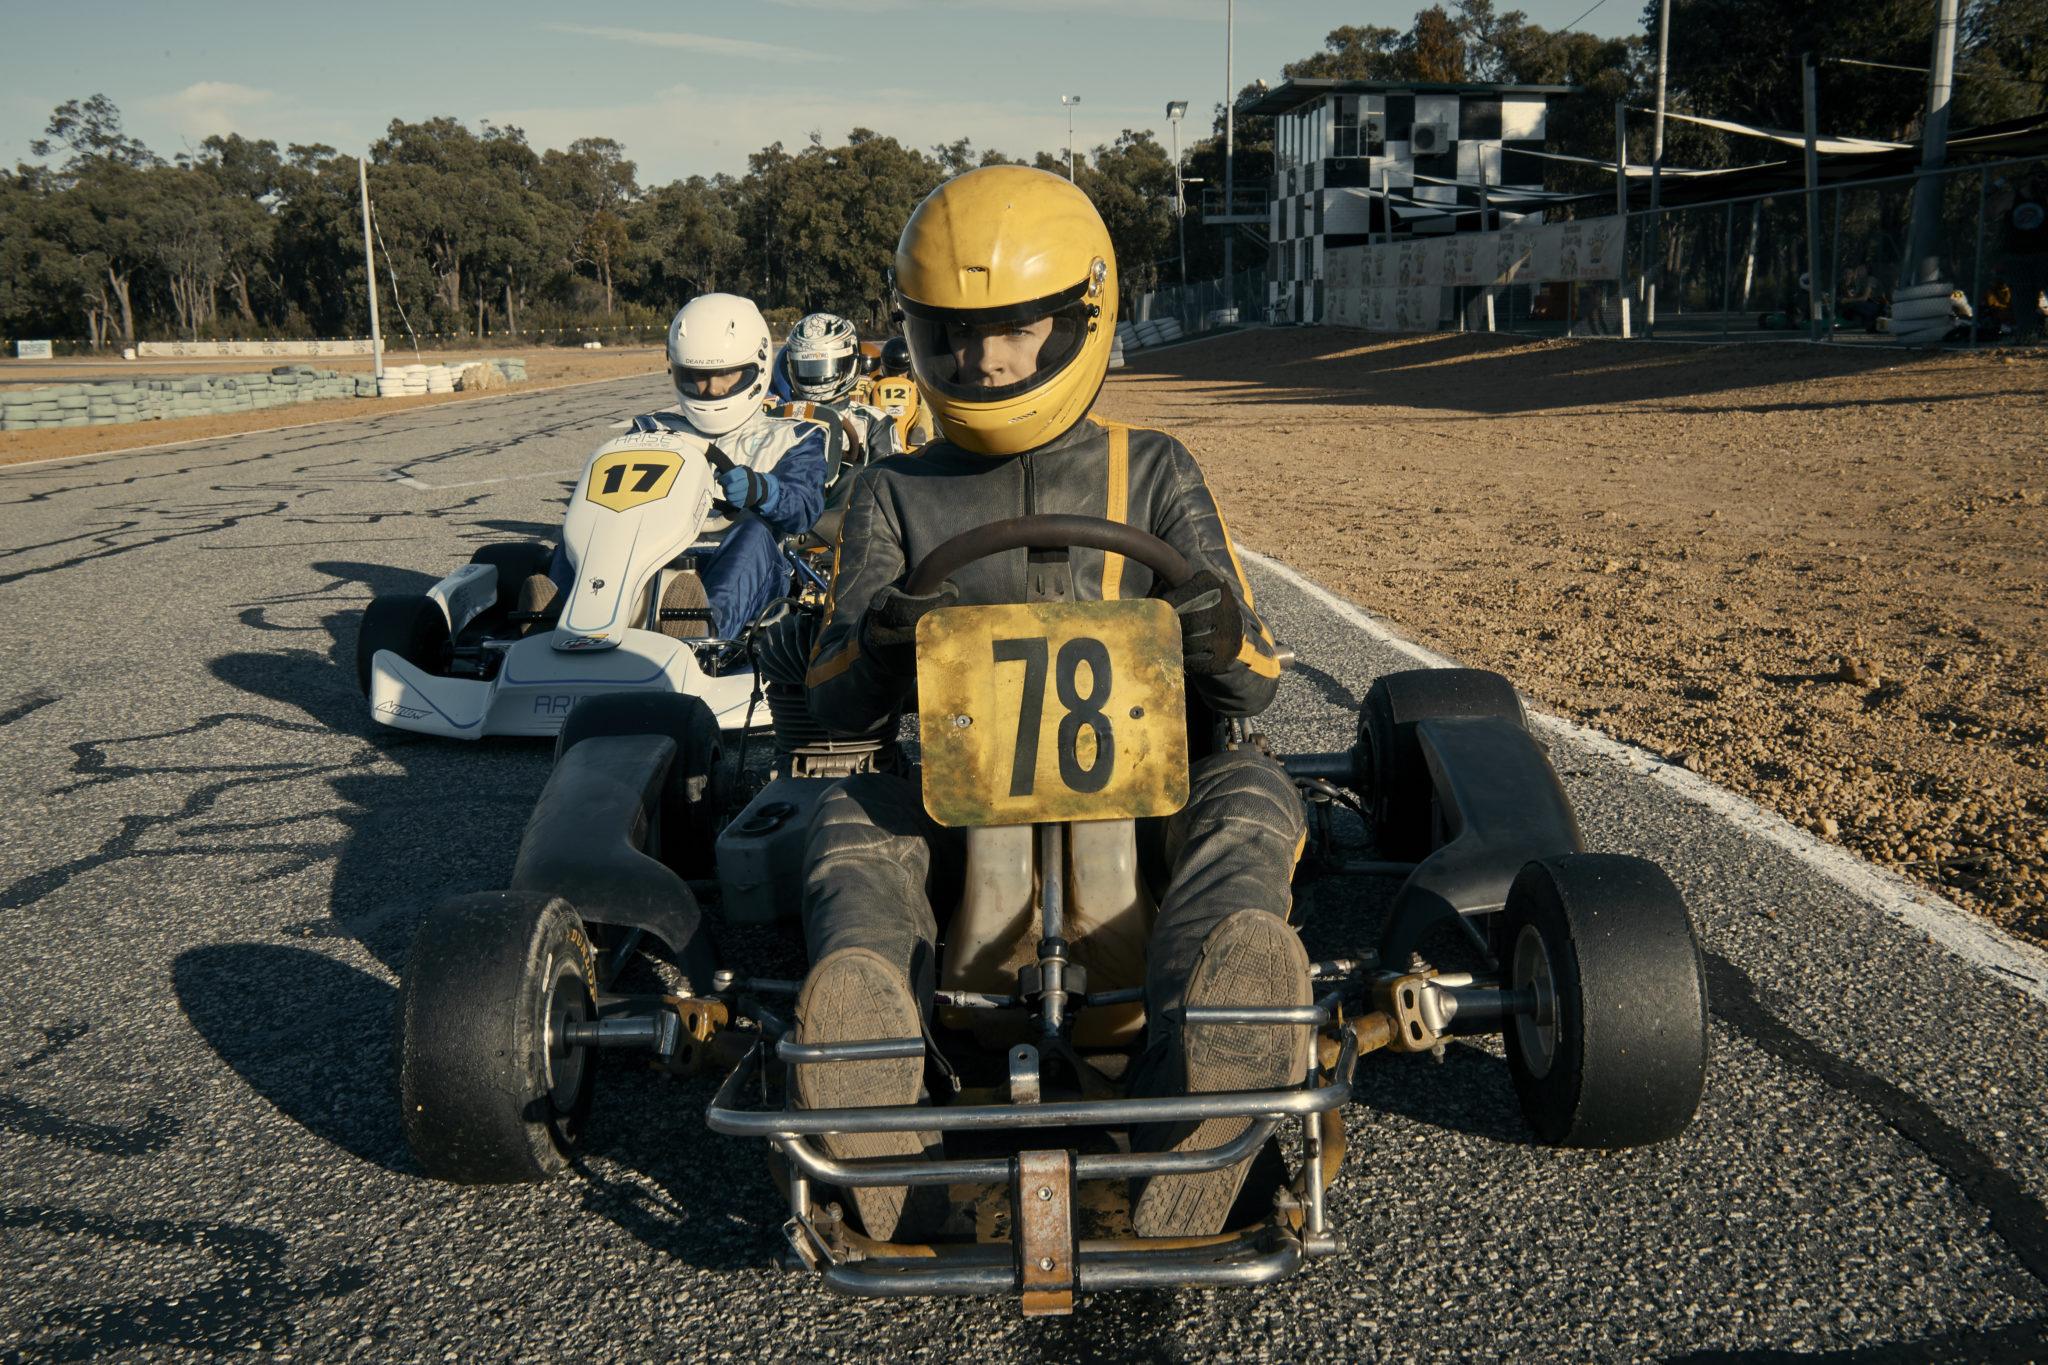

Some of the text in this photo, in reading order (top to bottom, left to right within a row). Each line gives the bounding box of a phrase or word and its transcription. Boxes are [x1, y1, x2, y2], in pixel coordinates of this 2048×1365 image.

[884, 388, 907, 399] 12
[602, 464, 669, 494] 17
[534, 695, 591, 714] ARI
[992, 637, 1115, 798] 78
